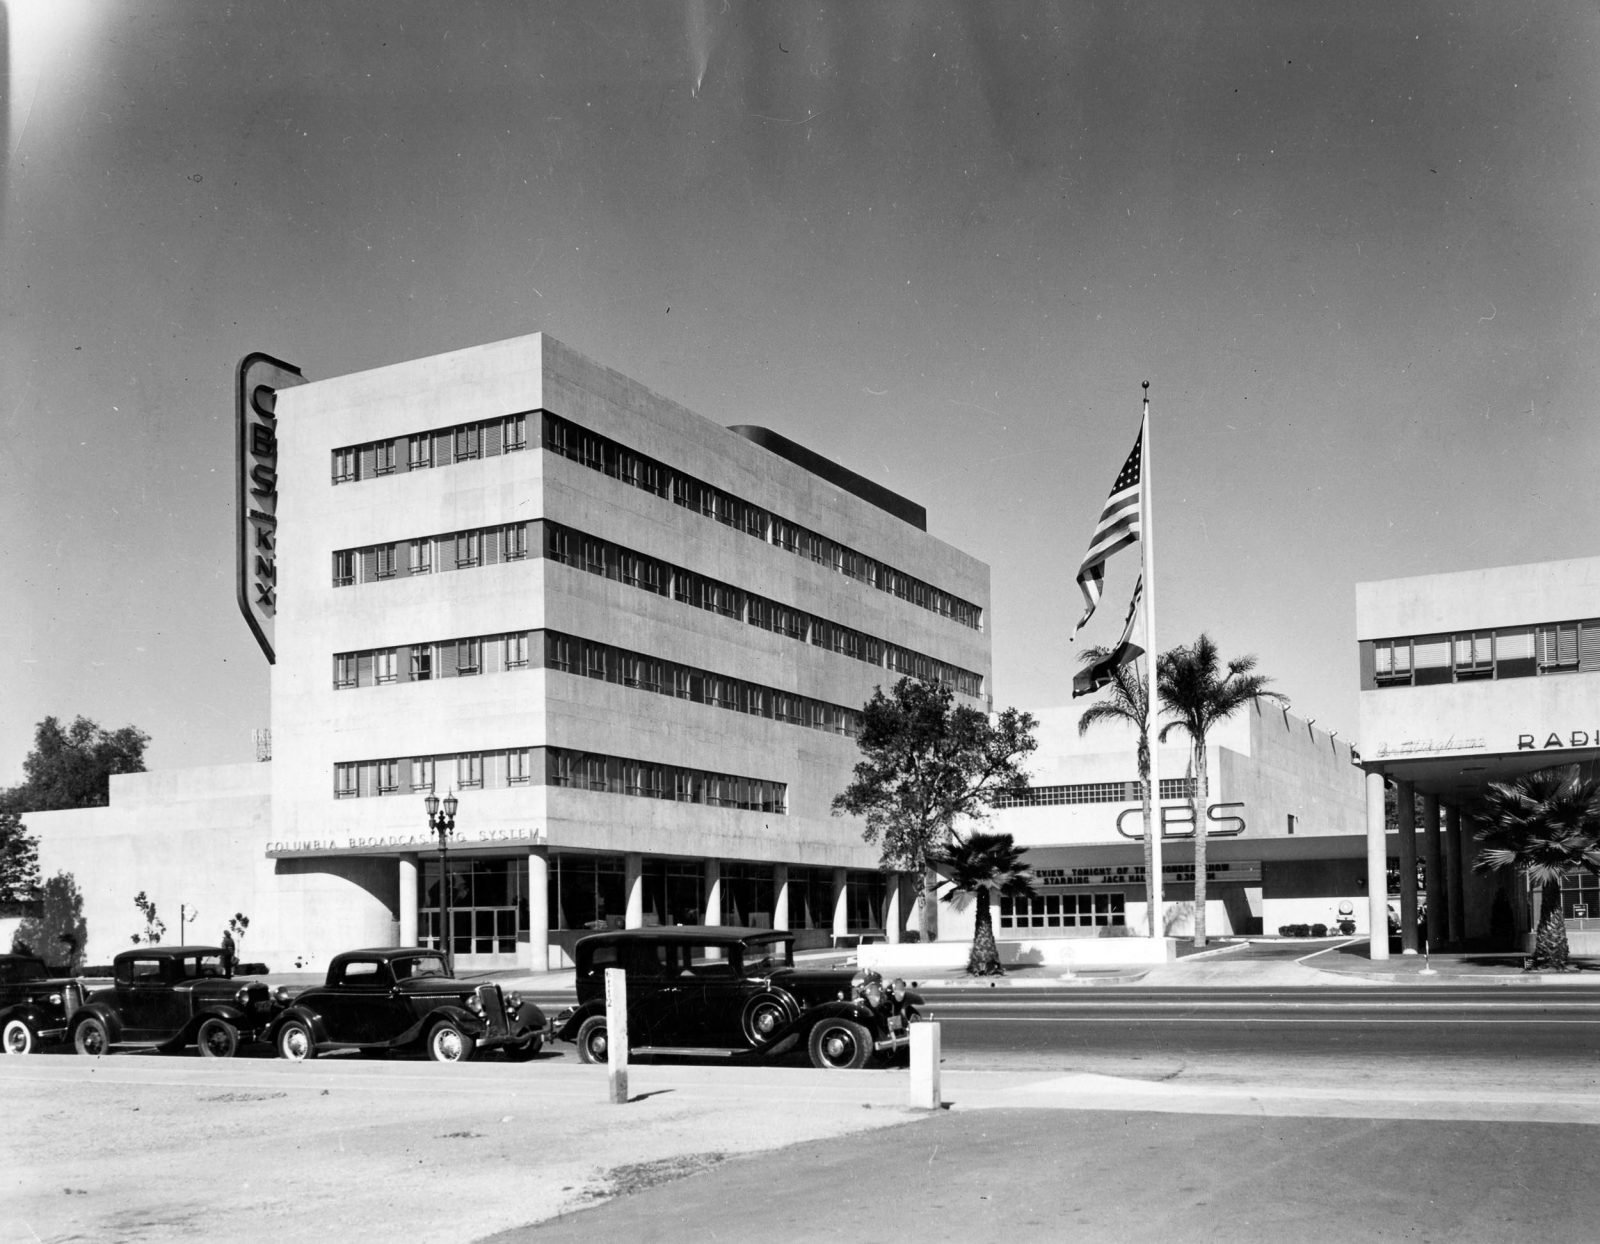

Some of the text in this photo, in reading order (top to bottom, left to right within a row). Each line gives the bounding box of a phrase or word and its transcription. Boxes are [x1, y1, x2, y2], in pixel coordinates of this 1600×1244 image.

[250, 384, 276, 497] CBS
[255, 527, 275, 606] KNX
[1117, 802, 1246, 840] CBS
[265, 828, 540, 852] COLUMBIA BROADCASTNG SYSTEM
[1043, 877, 1089, 885] STARRING
[1101, 875, 1125, 883] JACK
[1072, 867, 1111, 876] TONIGHT
[1117, 867, 1129, 875] OF
[1133, 866, 1147, 874] TH
